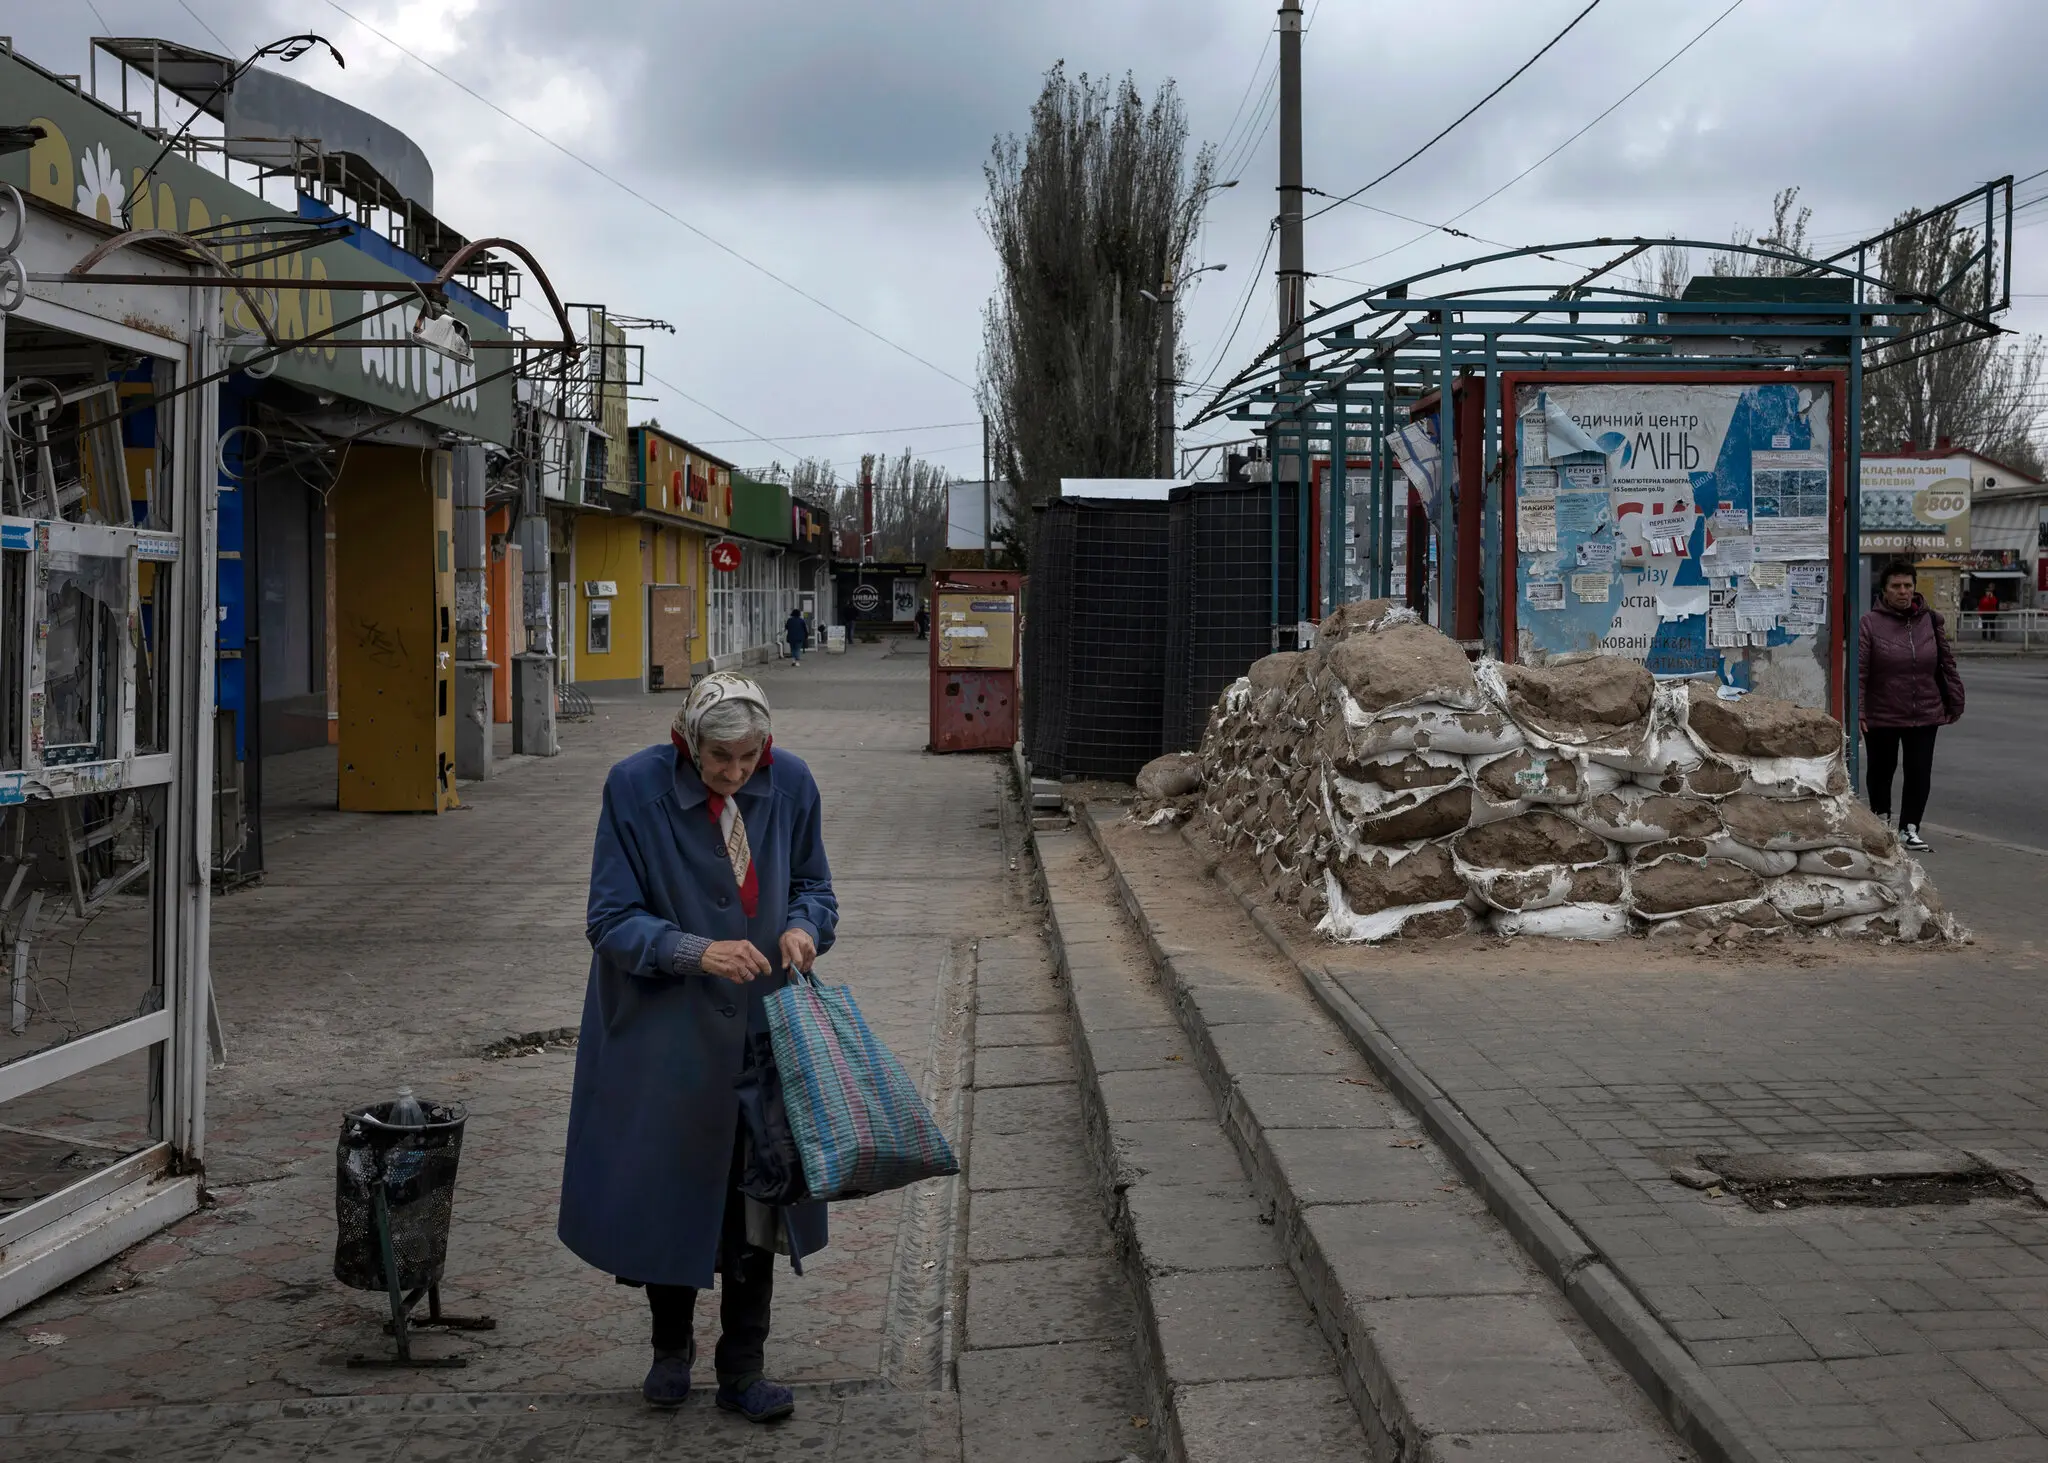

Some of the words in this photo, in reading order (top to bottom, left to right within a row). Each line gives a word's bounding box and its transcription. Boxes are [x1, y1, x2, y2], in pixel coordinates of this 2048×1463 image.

[361, 290, 478, 413] АПТЕКА
[1571, 412, 1644, 430] едичний
[1649, 414, 1698, 430] центр
[1917, 496, 1965, 512] 2800
[1649, 517, 1685, 527] ПЕРЕТЯЖКА
[1954, 537, 1963, 547] 5
[719, 549, 732, 566] 4
[852, 594, 879, 602] URBAN
[1621, 596, 1657, 608] остан
[1599, 633, 1647, 649] ковані
